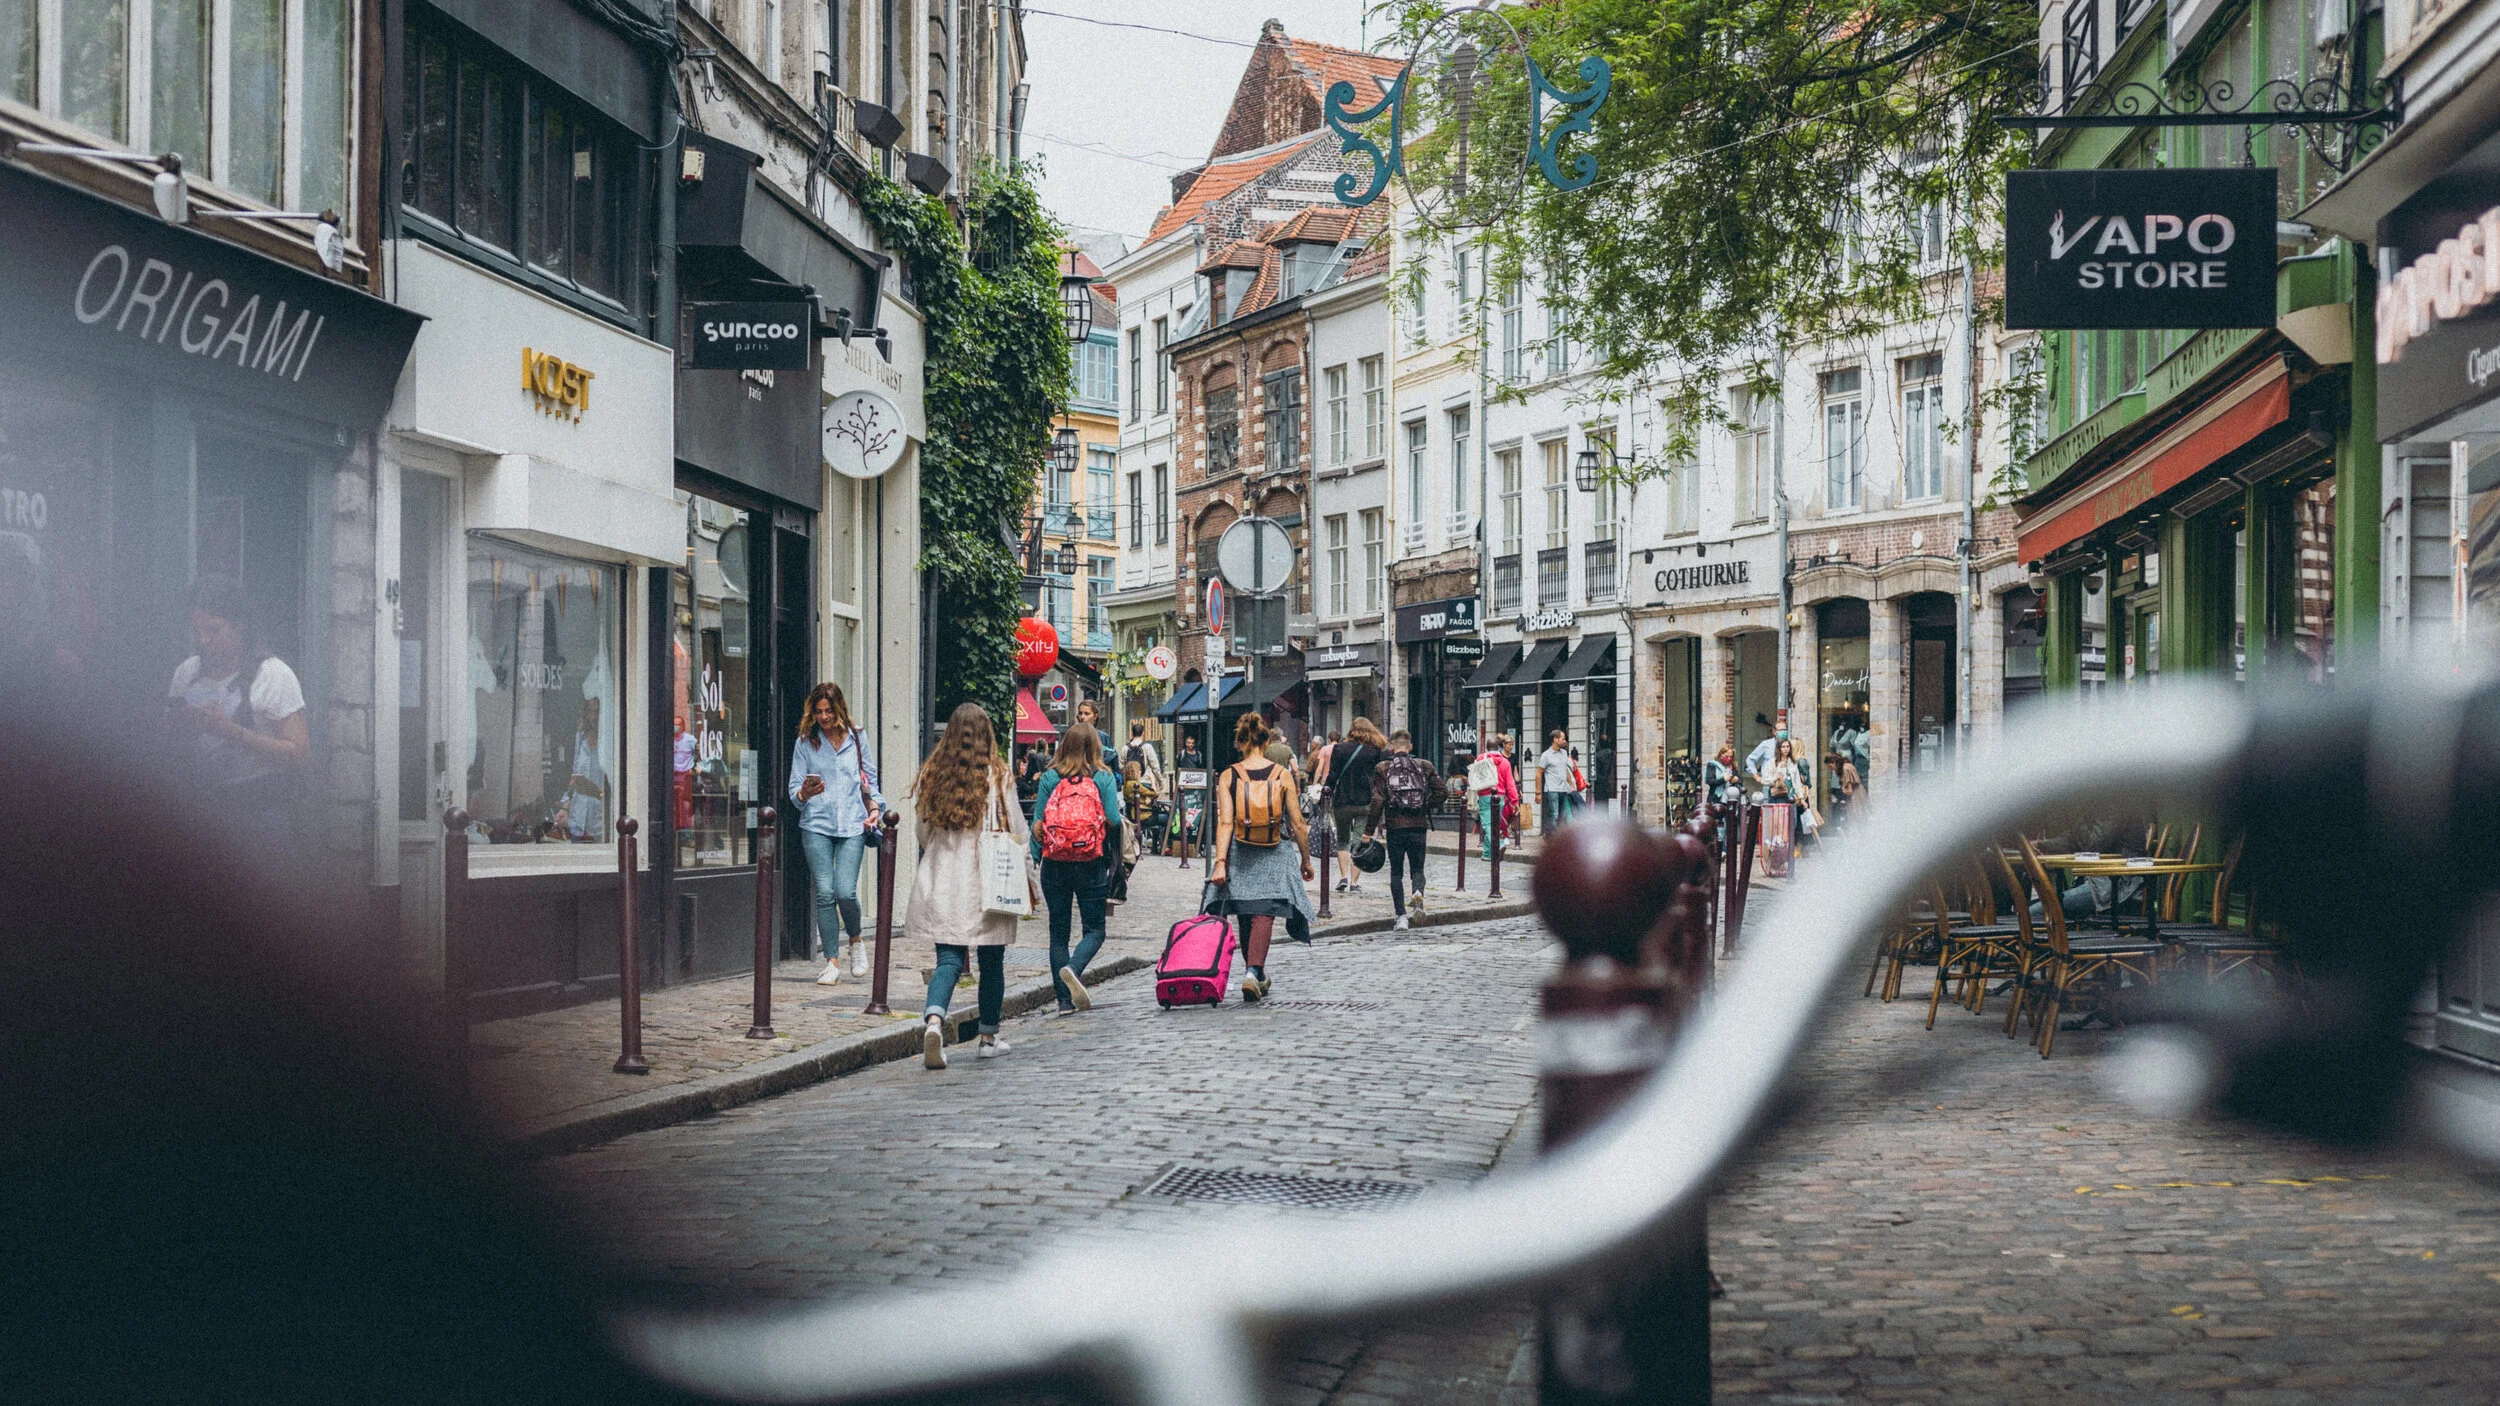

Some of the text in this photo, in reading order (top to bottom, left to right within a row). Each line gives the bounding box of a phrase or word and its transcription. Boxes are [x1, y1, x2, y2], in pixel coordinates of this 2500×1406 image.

[2049, 209, 2236, 260] VAPO
[2078, 261, 2229, 289] STORE
[75, 245, 325, 382] ORIGAMI
[703, 321, 799, 342] suncoo
[735, 342, 769, 352] paris
[522, 347, 595, 411] KOST
[2468, 346, 2500, 387] Cigar
[1655, 560, 1751, 592] COTHURNE
[1449, 618, 1473, 626] FAGUO
[1528, 610, 1574, 632] Bizzbee
[1446, 645, 1481, 654] Bizzbee
[700, 670, 723, 711] Sol
[699, 719, 723, 760] des
[1449, 722, 1477, 743] Soldes
